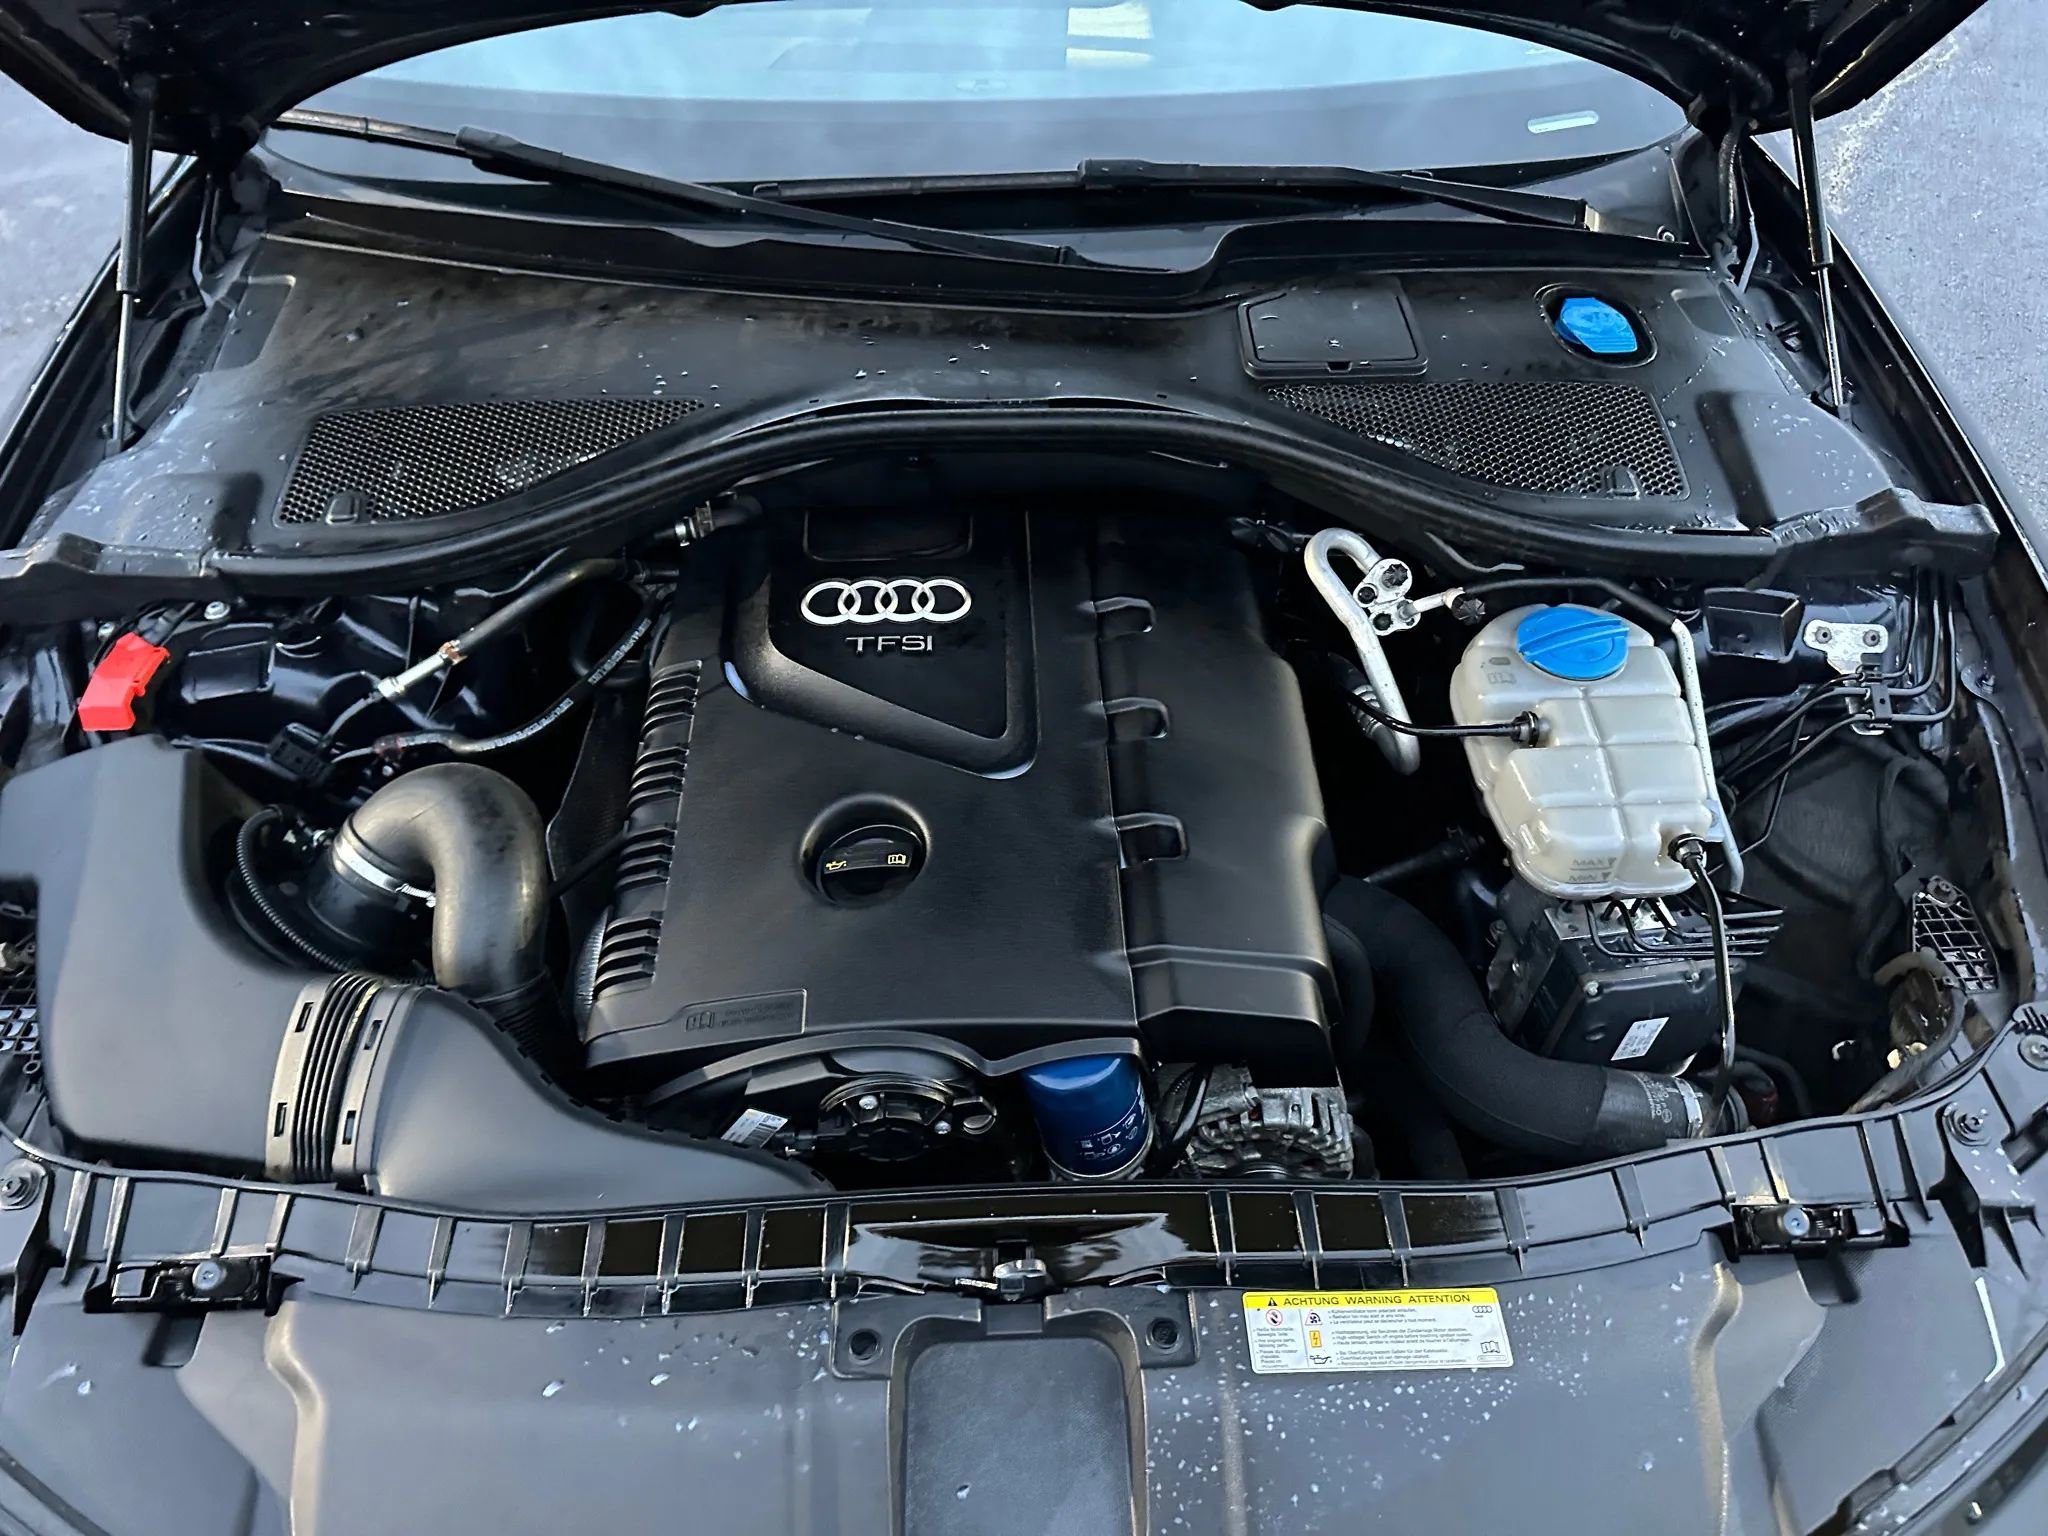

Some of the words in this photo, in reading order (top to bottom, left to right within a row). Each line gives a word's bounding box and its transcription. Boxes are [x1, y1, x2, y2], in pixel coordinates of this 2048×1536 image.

[845, 634, 933, 654] TFSI
[1571, 857, 1604, 866] MAX
[1283, 1296, 1340, 1306] ACHTUNG
[1345, 1295, 1402, 1305] WARNING
[1408, 1293, 1471, 1304] ATTENTION
